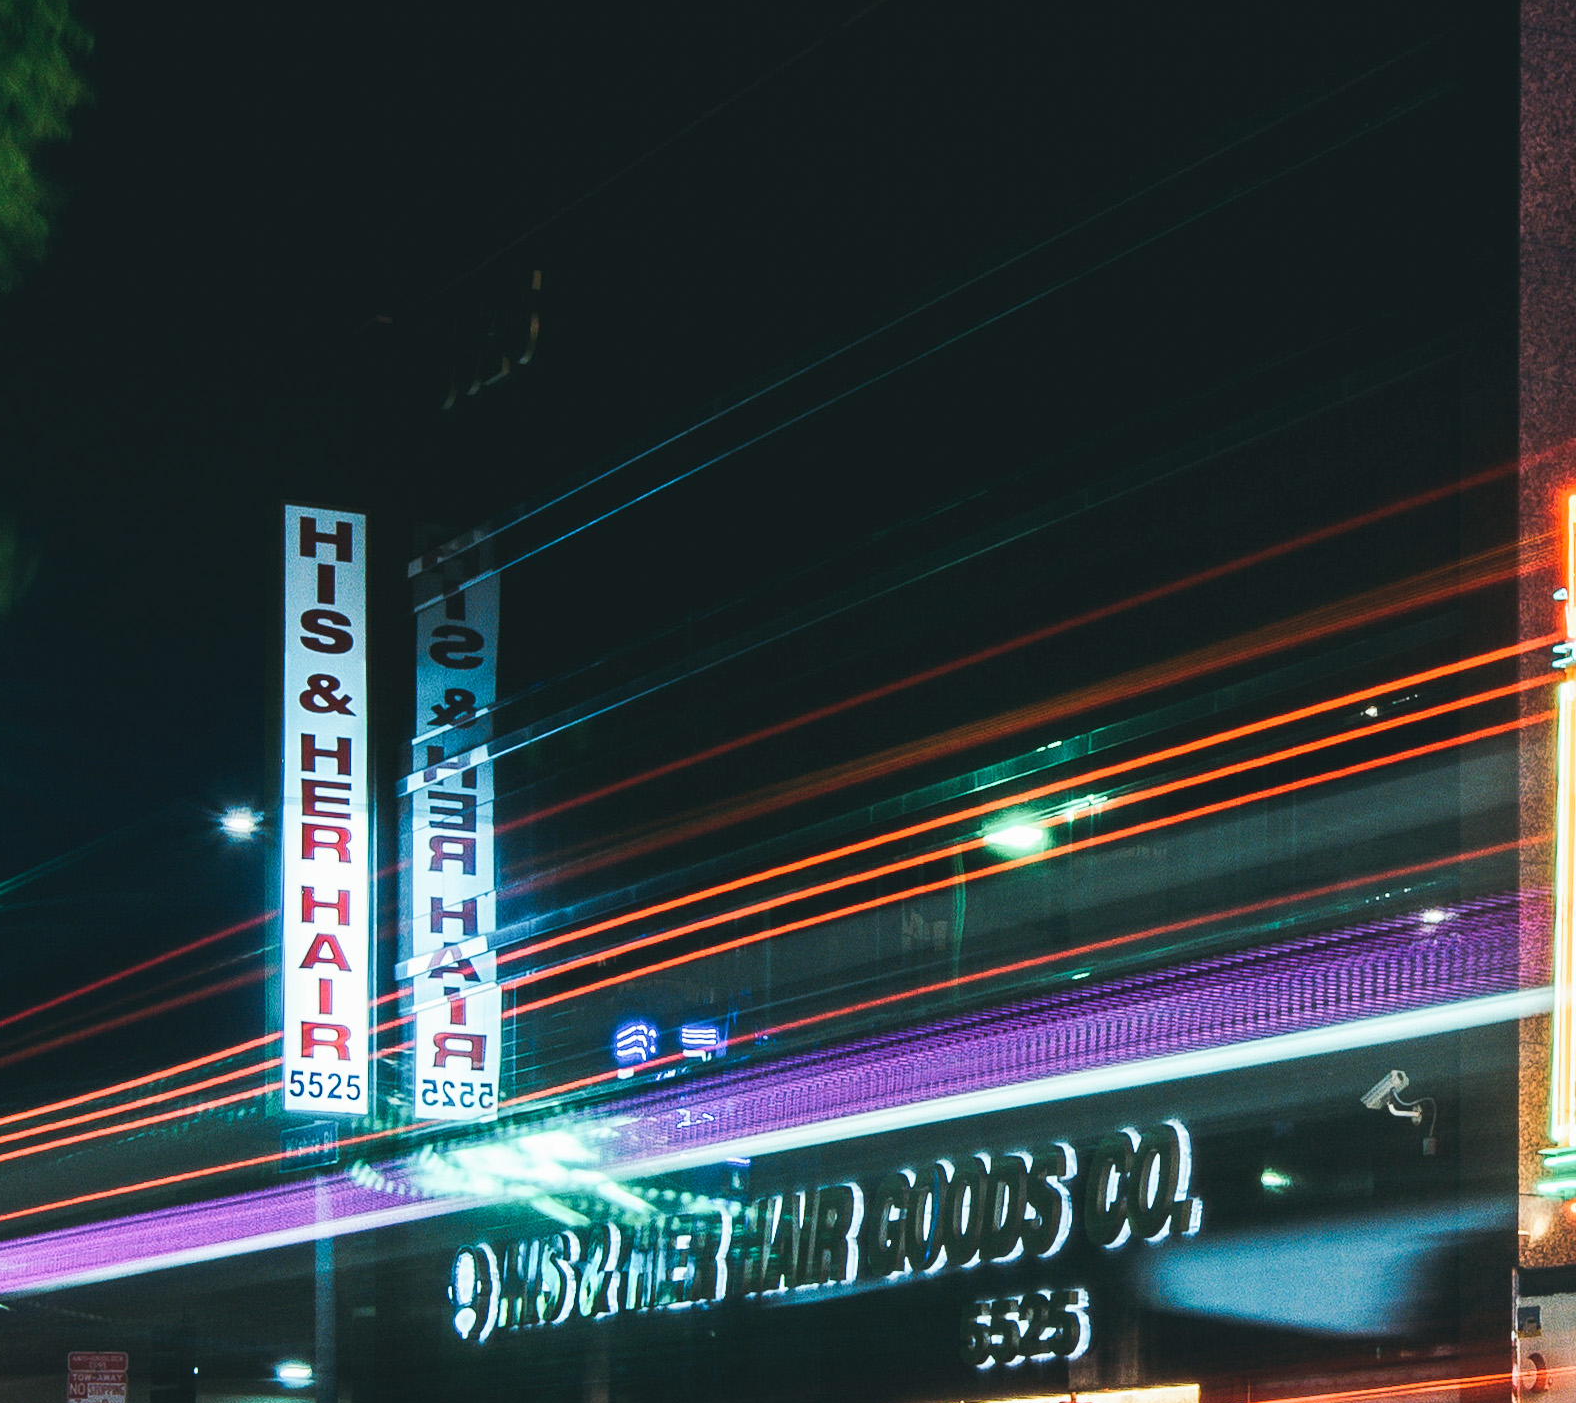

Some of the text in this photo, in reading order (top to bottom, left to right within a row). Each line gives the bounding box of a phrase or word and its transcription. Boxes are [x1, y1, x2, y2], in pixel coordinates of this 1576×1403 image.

[298, 515, 356, 1061] HIS & HER HAIR
[288, 1070, 362, 1102] 5525
[960, 1286, 1092, 1372] 5525
[69, 1383, 86, 1396] NO
